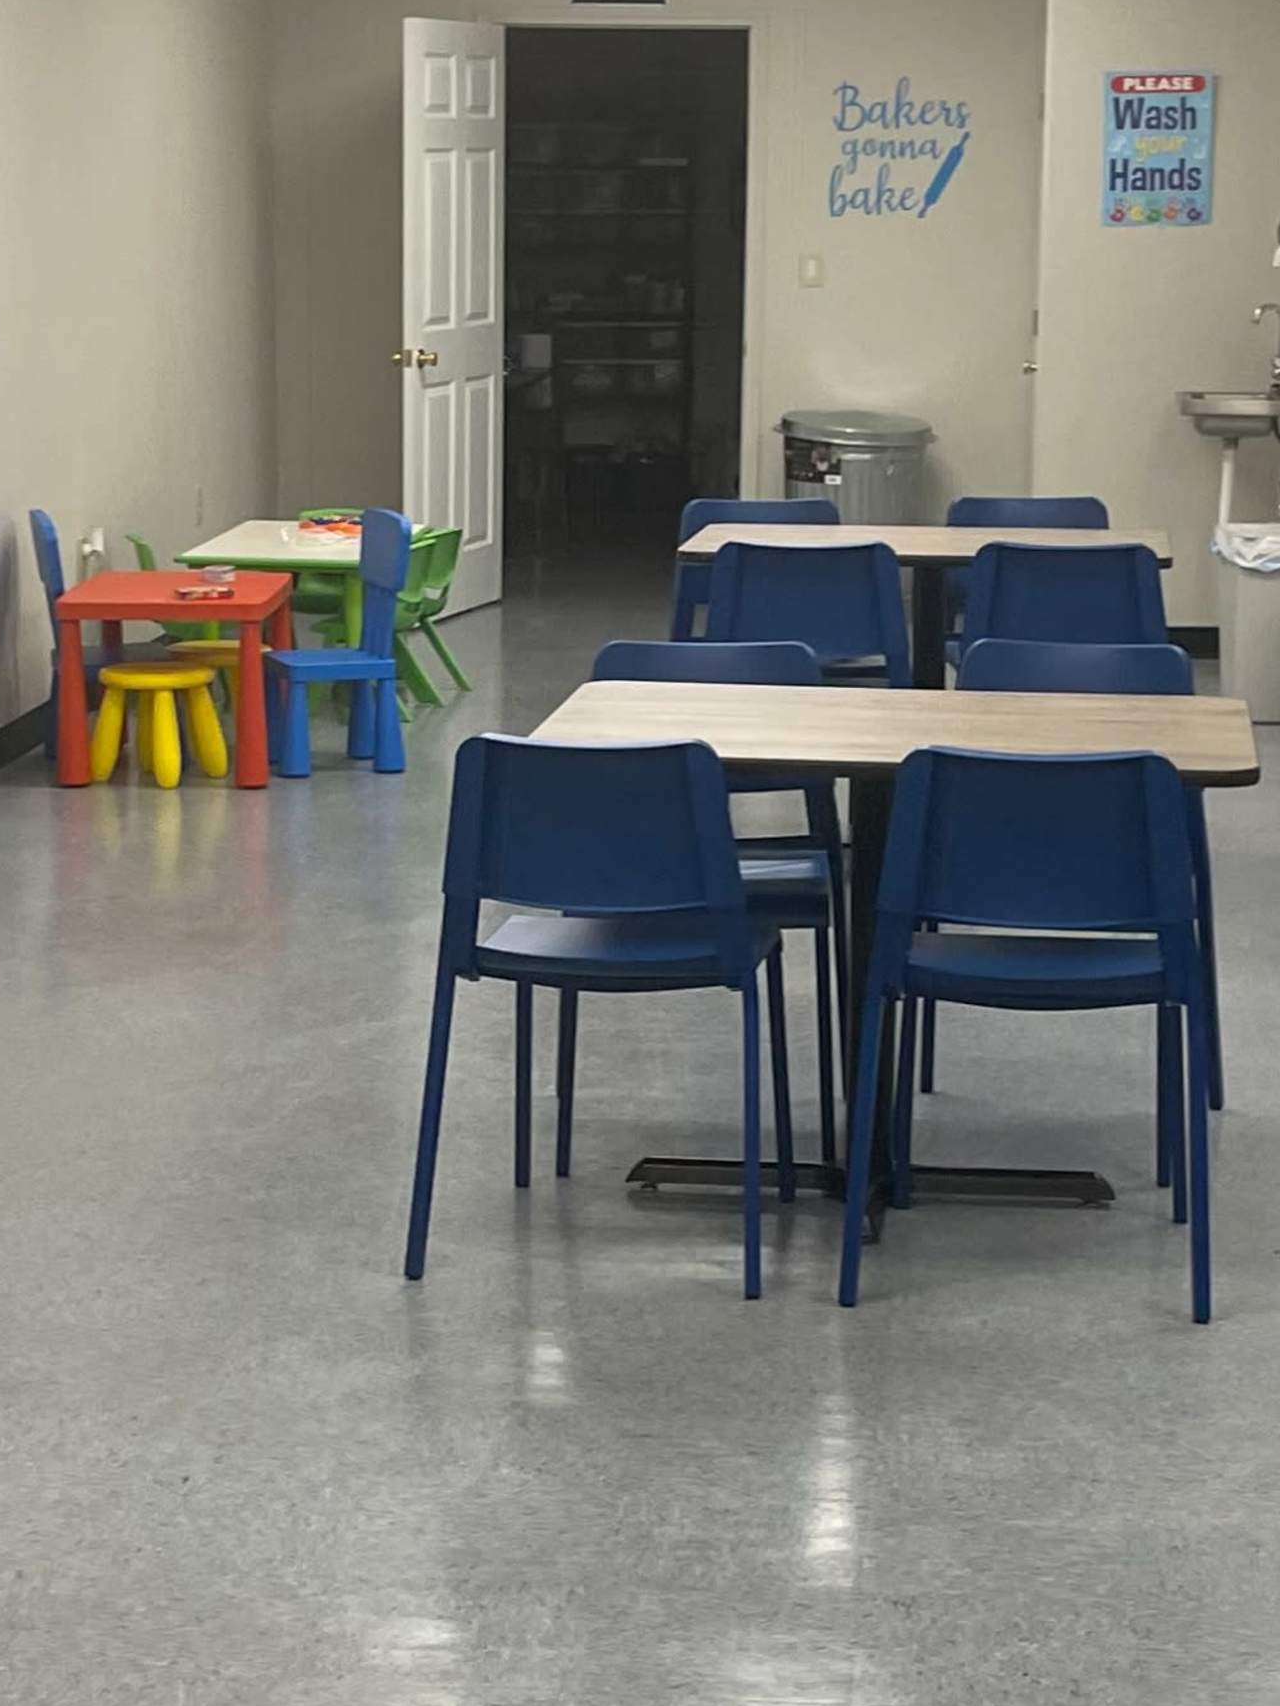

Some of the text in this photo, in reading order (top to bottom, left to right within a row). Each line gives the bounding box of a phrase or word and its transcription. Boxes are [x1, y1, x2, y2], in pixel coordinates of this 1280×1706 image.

[1122, 77, 1194, 91] PLEASE
[832, 76, 971, 131] Bakers
[1113, 96, 1197, 130] Wash
[841, 139, 942, 175] gonna
[1135, 135, 1188, 162] your
[829, 163, 920, 217] bake
[1109, 158, 1202, 192] Hands
